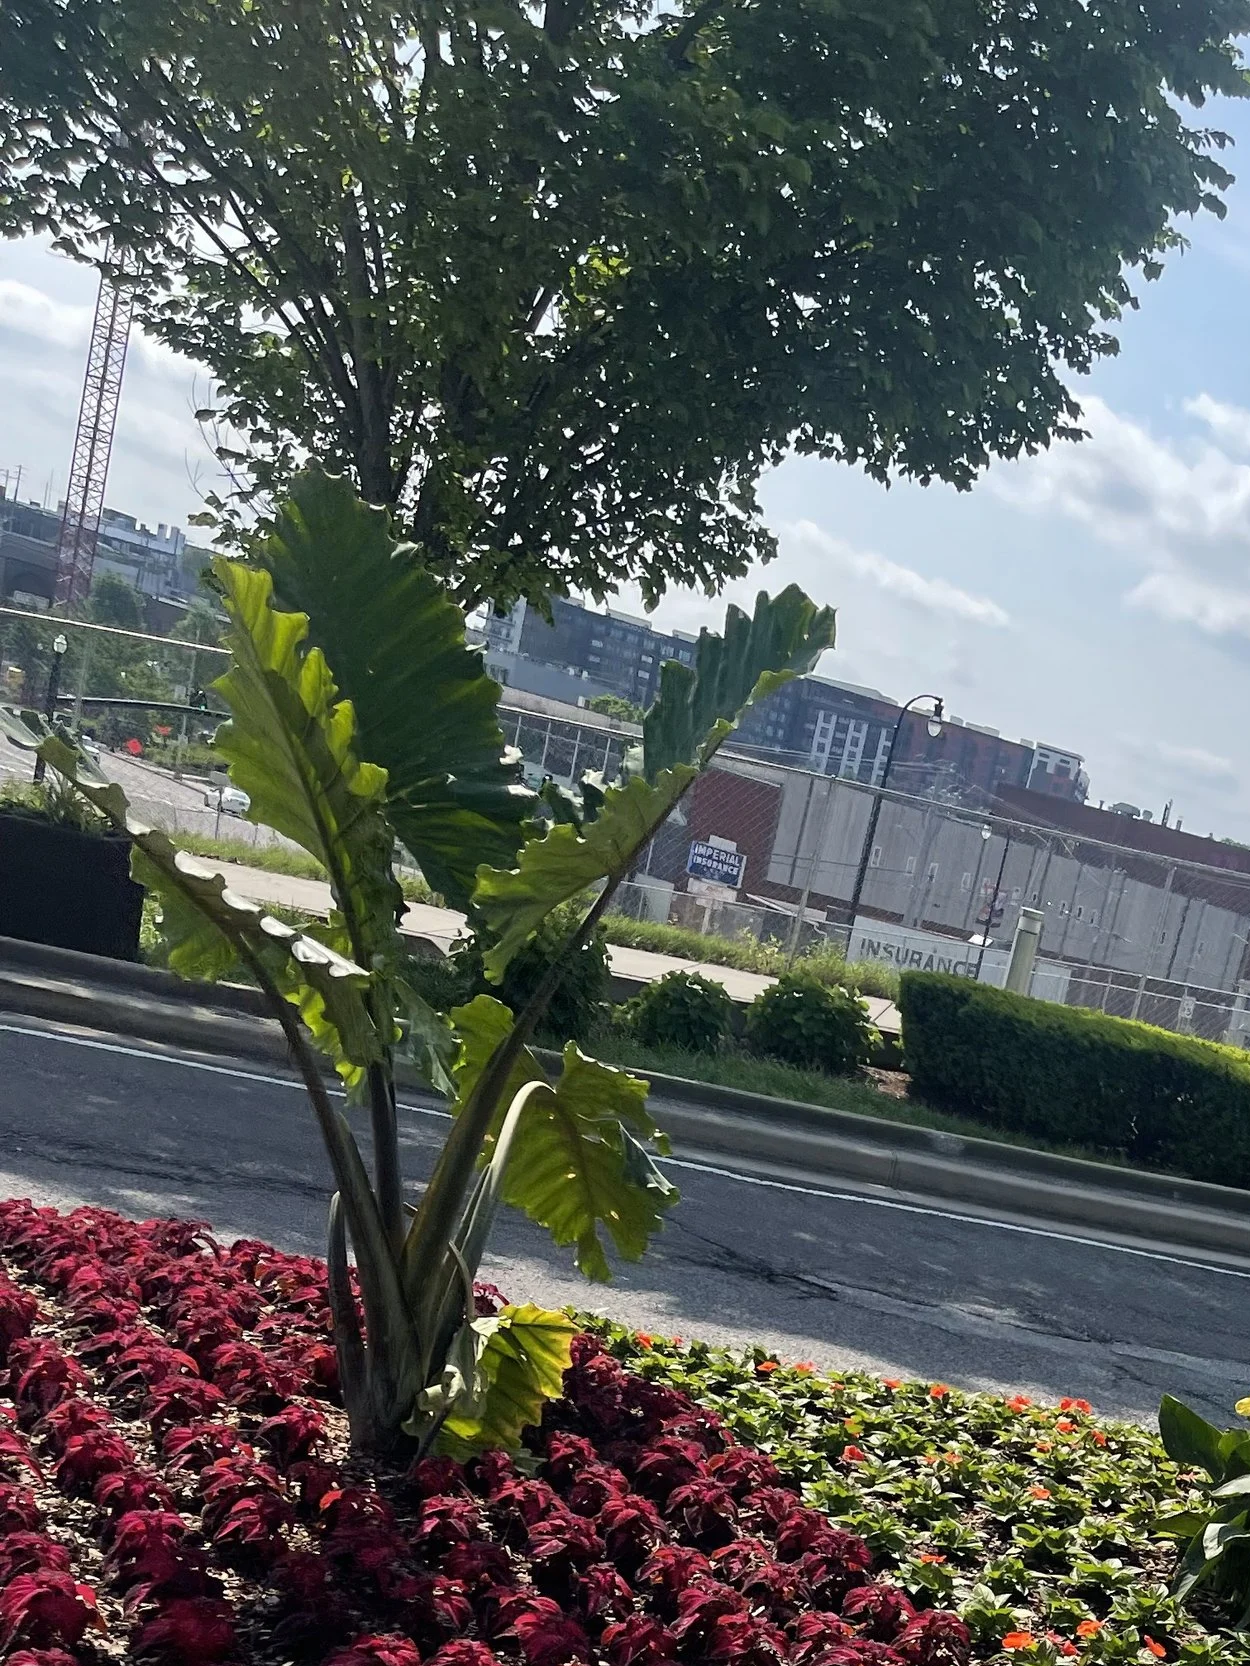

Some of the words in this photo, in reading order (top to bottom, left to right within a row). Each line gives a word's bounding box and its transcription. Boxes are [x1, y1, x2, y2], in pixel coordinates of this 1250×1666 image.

[692, 855, 740, 875] INSURANCE
[694, 844, 740, 866] IMPERIAL
[860, 938, 980, 980] INSURANCE
